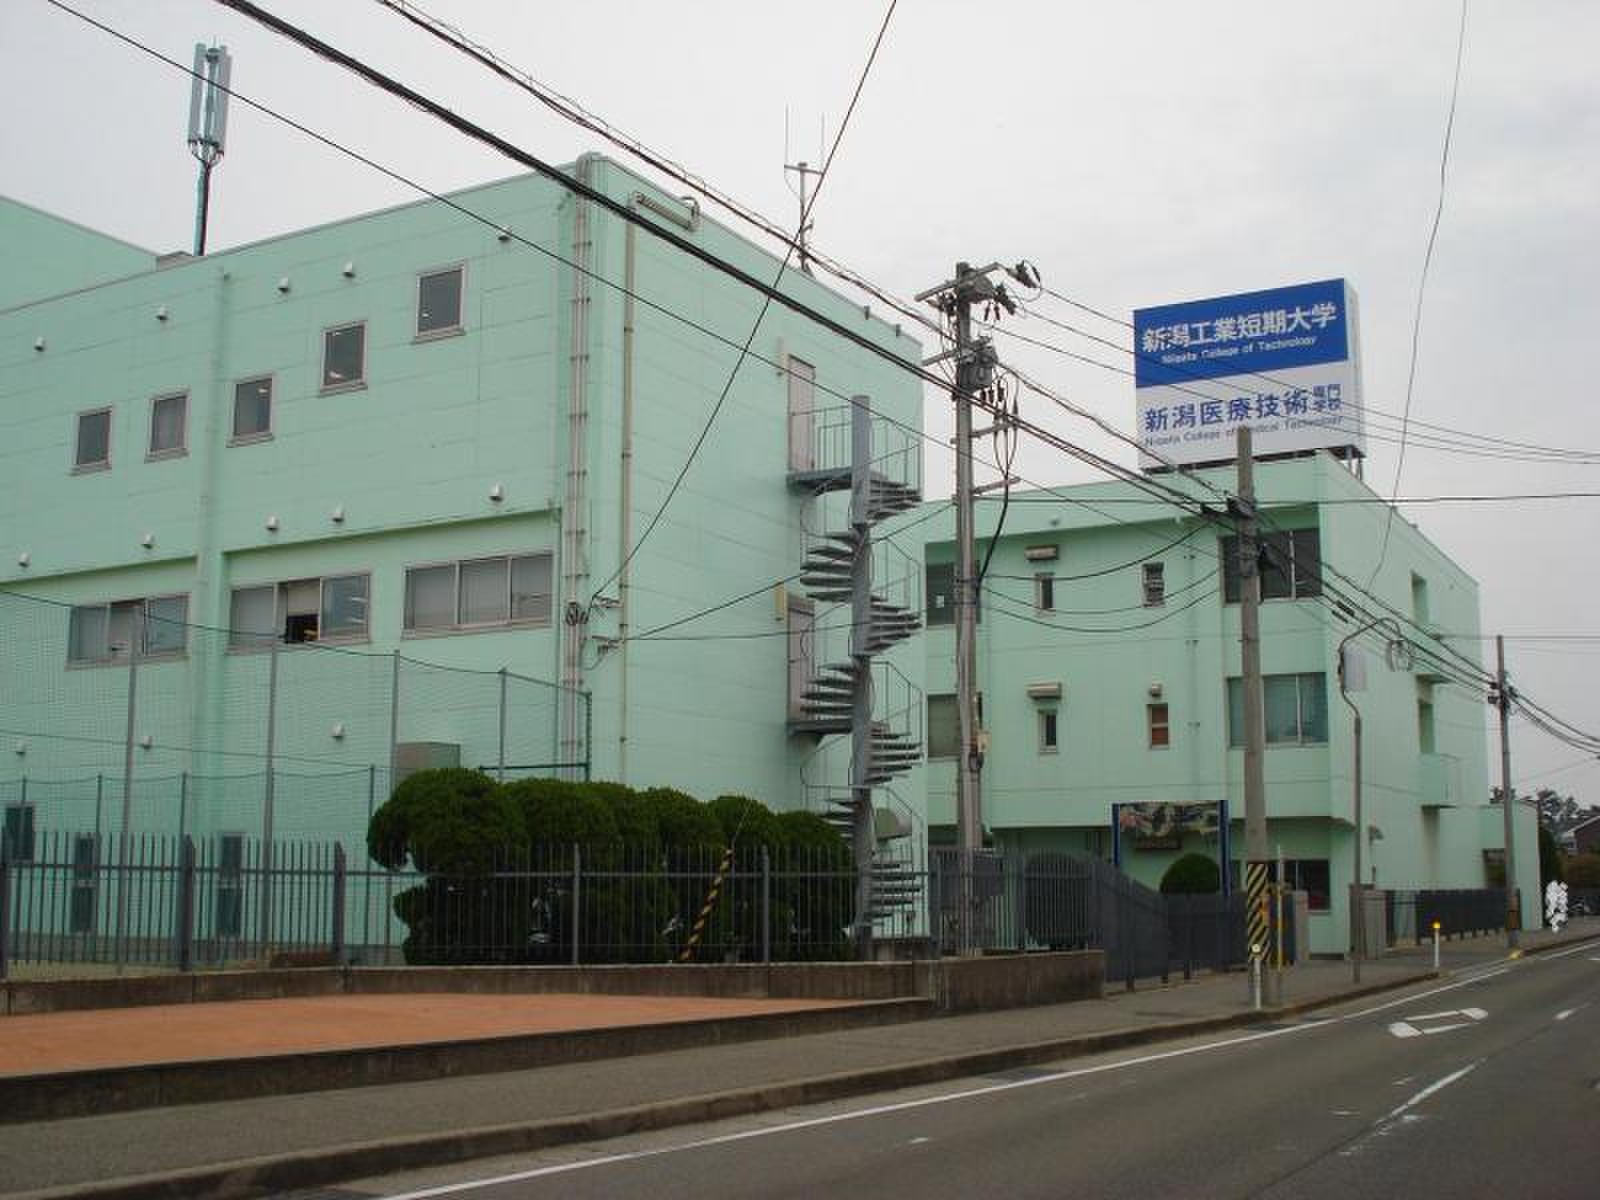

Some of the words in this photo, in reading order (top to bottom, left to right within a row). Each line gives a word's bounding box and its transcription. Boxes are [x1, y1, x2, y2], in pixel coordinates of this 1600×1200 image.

[1142, 302, 1337, 353] 新潟工業短期大学
[1244, 342, 1255, 353] of
[1257, 335, 1316, 352] Technology
[1184, 429, 1221, 443] College
